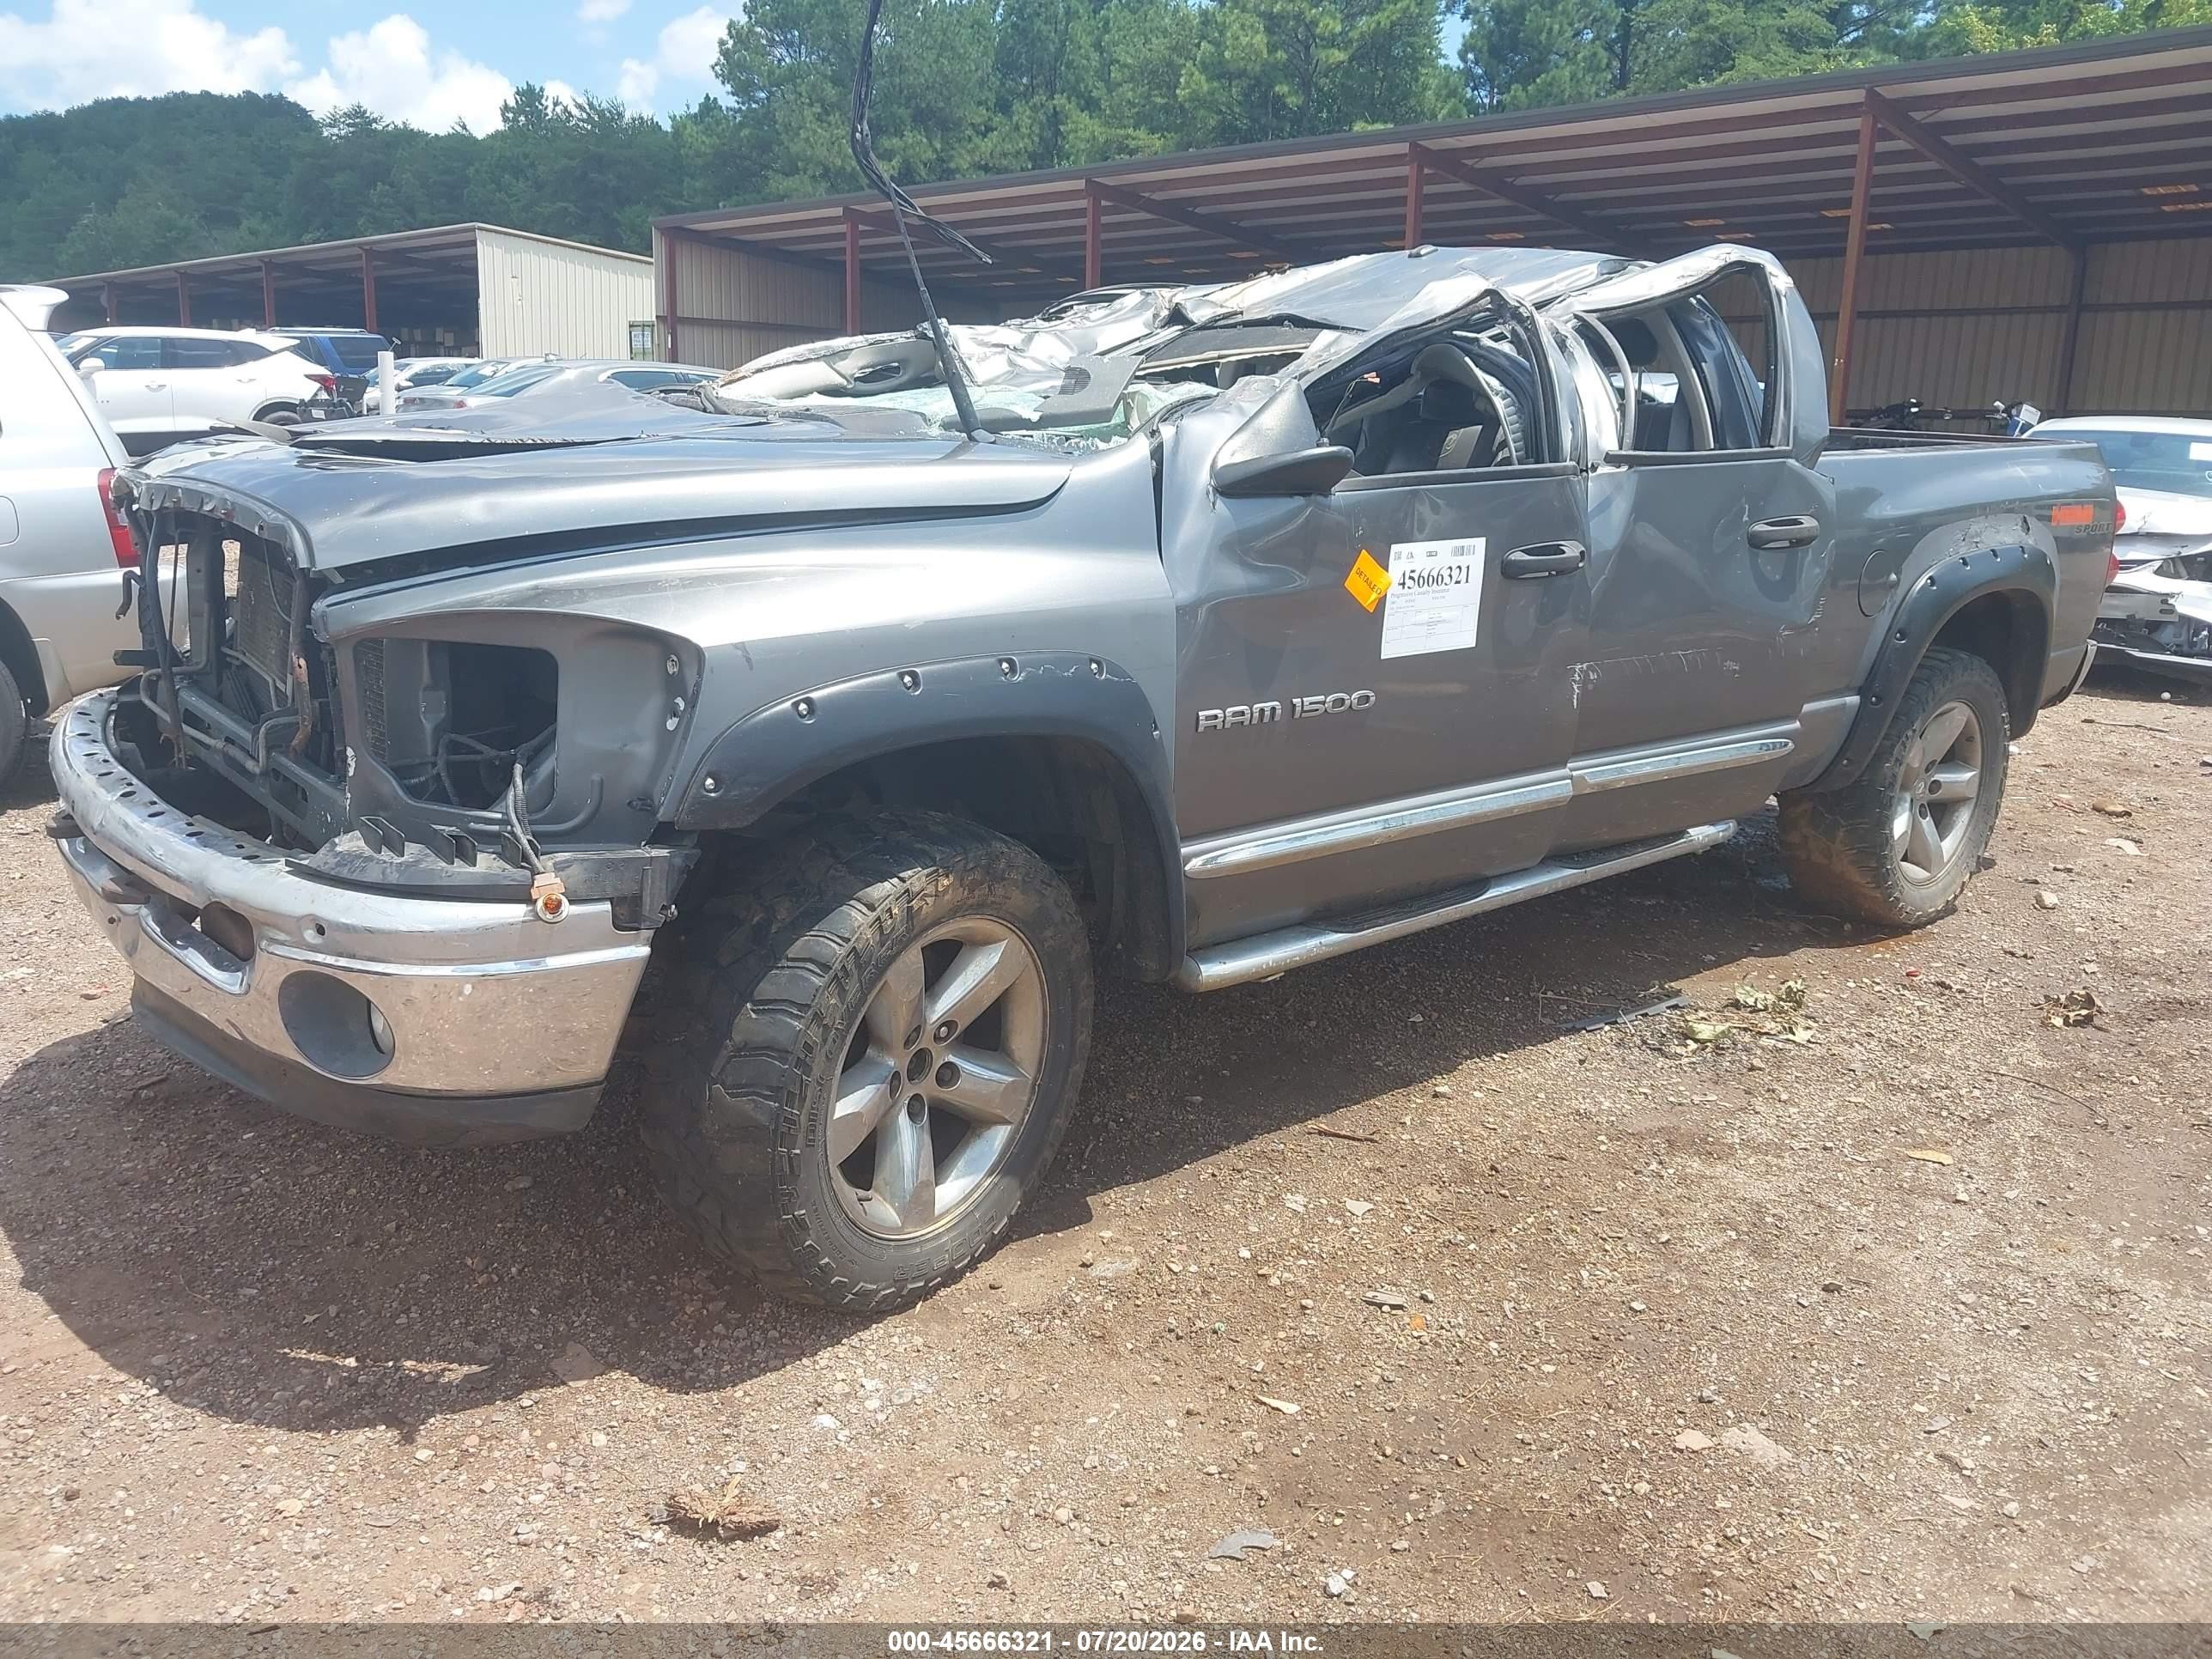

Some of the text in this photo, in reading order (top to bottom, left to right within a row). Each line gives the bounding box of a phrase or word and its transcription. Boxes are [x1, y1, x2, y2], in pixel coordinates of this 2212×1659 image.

[2075, 522, 2112, 535] SPORT
[1356, 567, 1382, 595] DETAILED
[1398, 564, 1471, 590] 45666321
[1197, 690, 1376, 732] RAM 1500
